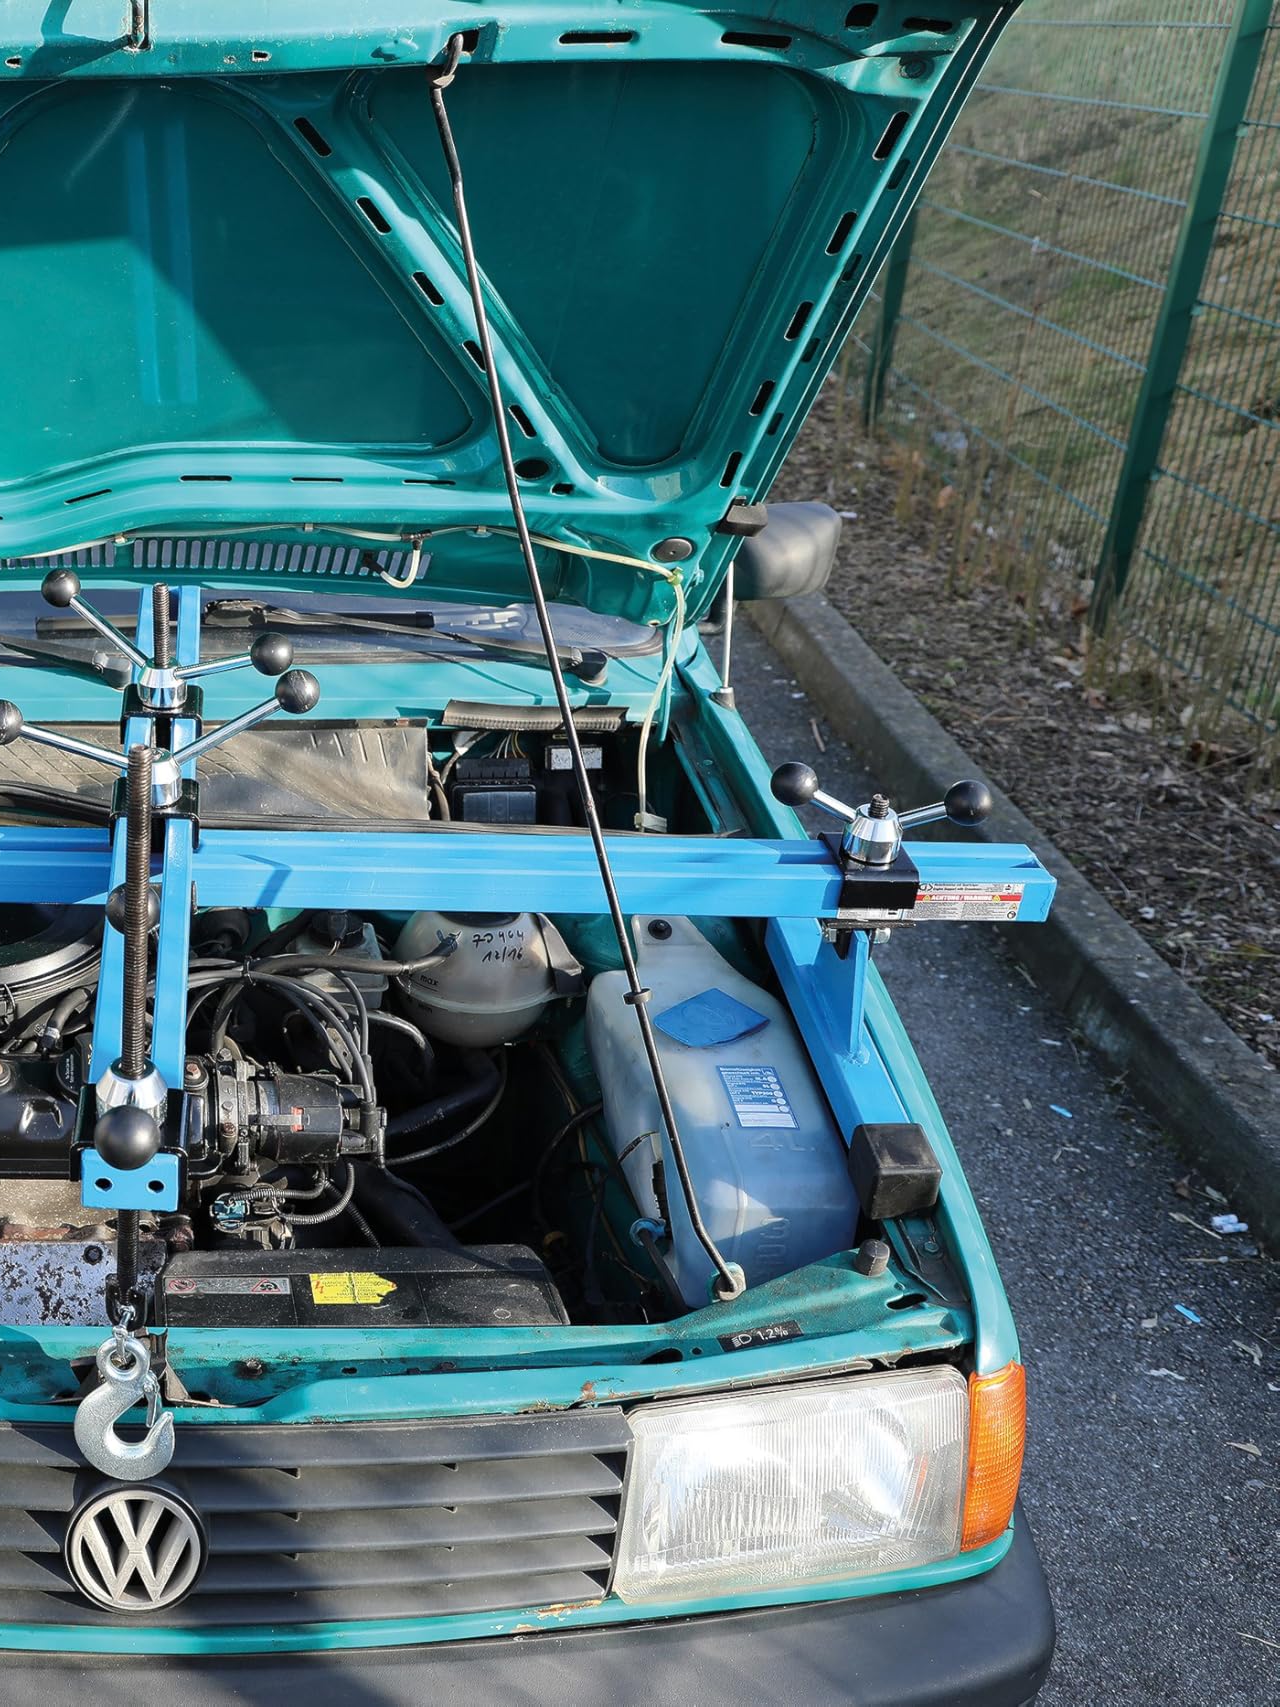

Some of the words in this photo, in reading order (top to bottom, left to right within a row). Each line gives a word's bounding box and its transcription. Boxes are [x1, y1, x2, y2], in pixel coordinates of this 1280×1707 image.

[420, 974, 439, 986] max
[756, 1326, 788, 1340] 1.2%
[70, 1488, 201, 1611] VW
